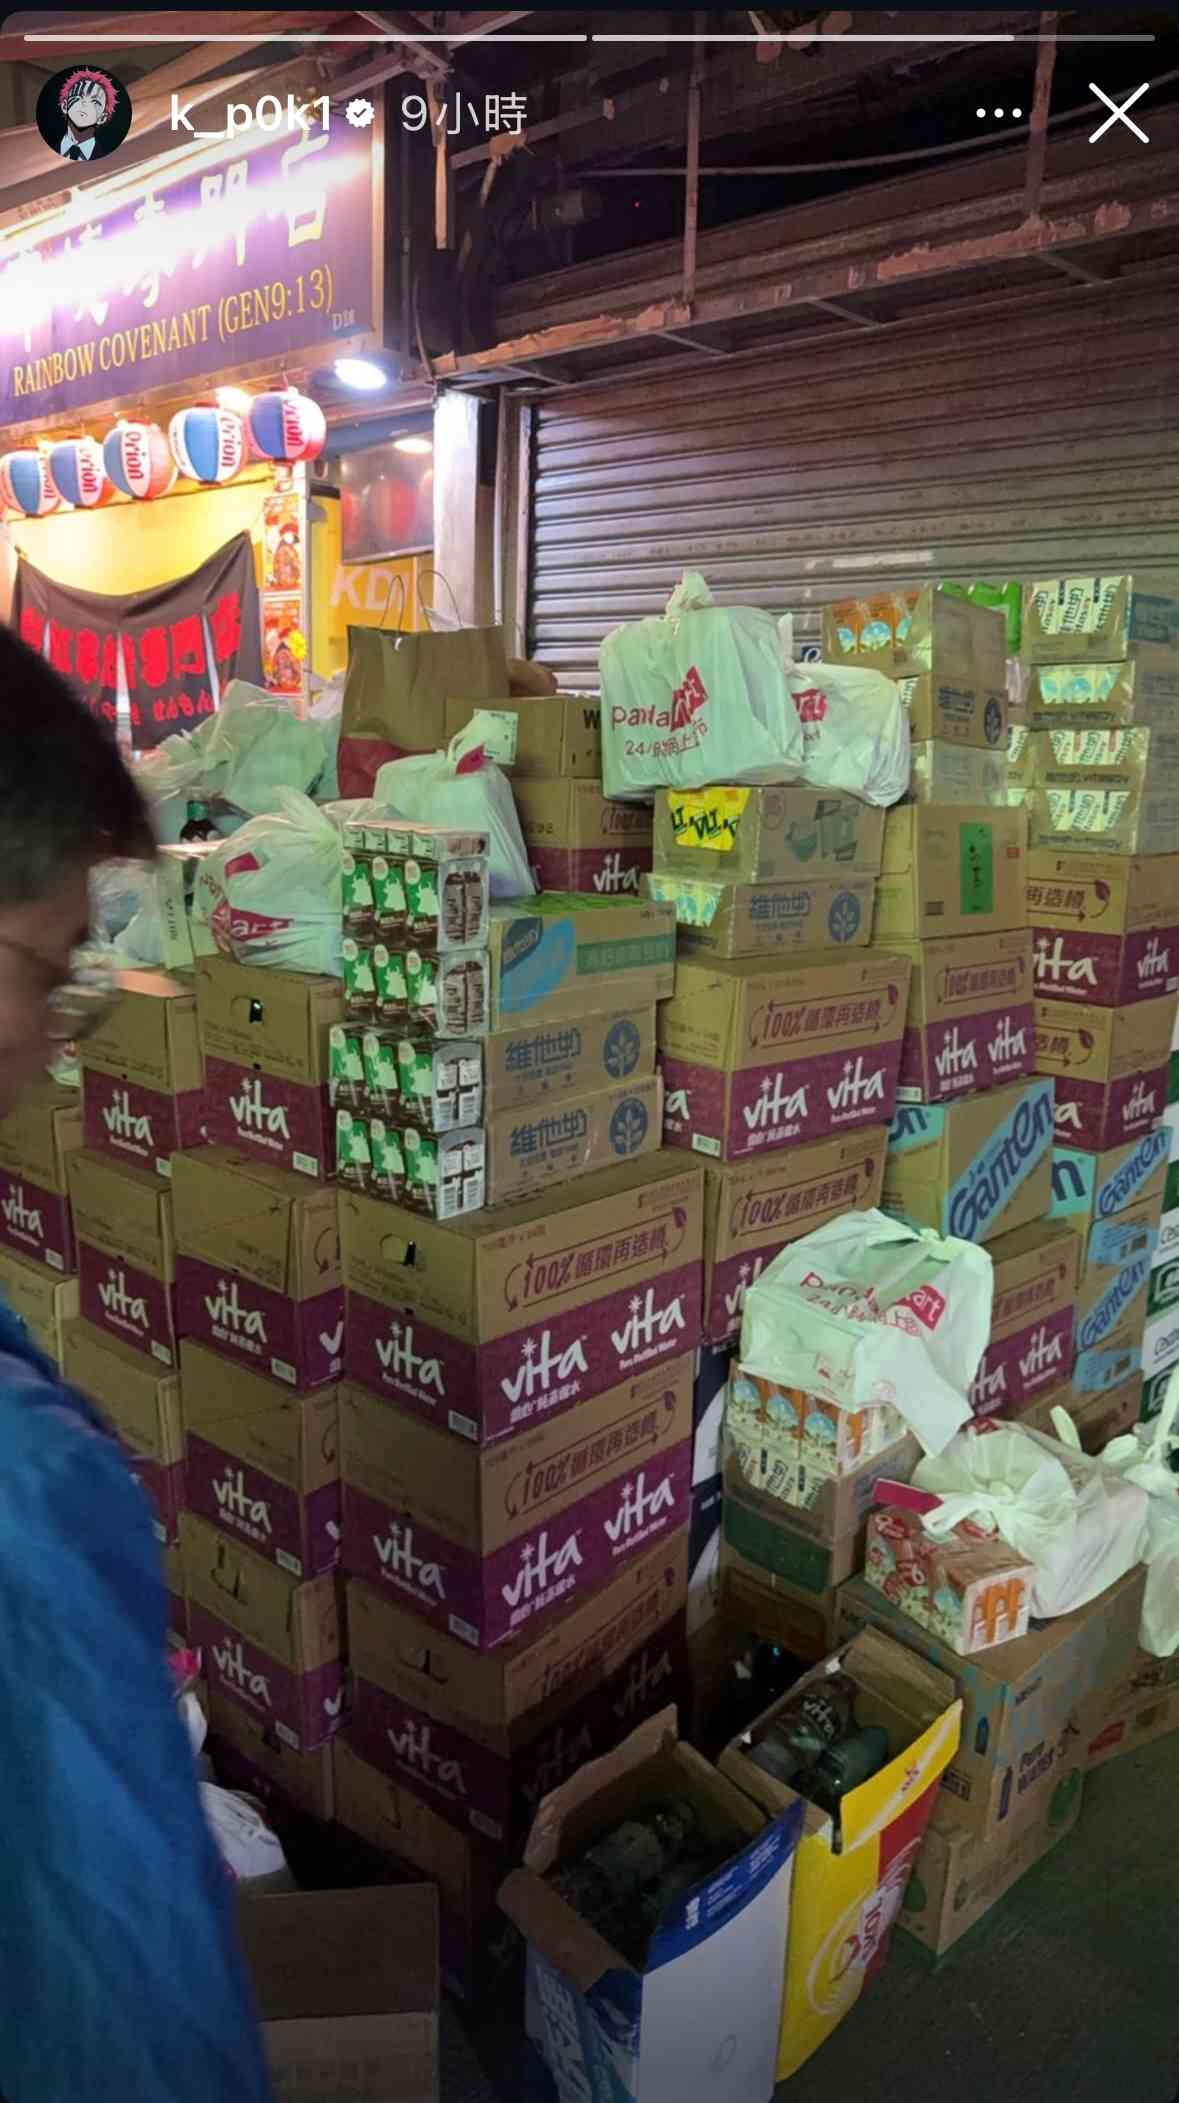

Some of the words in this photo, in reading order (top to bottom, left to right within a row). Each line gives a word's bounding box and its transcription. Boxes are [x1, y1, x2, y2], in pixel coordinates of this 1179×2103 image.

[13, 345, 95, 397] RAINBOW
[100, 304, 211, 372] COVENANT
[218, 264, 334, 345] (GEN9:13)
[80, 449, 98, 493] Orion
[125, 431, 144, 480] Orion
[221, 416, 240, 467] Orion
[1138, 937, 1169, 977] vita
[935, 1026, 978, 1076] vita
[987, 1015, 1026, 1062] vita
[230, 1078, 290, 1139] vita
[743, 1072, 808, 1129] vita
[827, 1056, 885, 1109] vita
[1123, 1082, 1155, 1121] vita
[103, 1089, 154, 1146] vita
[2, 1184, 44, 1238] vita
[98, 1268, 149, 1328] vita
[205, 1279, 268, 1343] vita
[725, 1257, 763, 1316] vi
[611, 1288, 686, 1354] vita
[376, 1321, 445, 1395] vita
[502, 1330, 588, 1402] vita
[1019, 1326, 1063, 1377] vita
[212, 1466, 272, 1534] vita
[604, 1472, 675, 1541] vita
[373, 1521, 446, 1600] vita
[502, 1531, 583, 1606] vita
[212, 1636, 272, 1707] vita
[387, 1719, 468, 1796] vita
